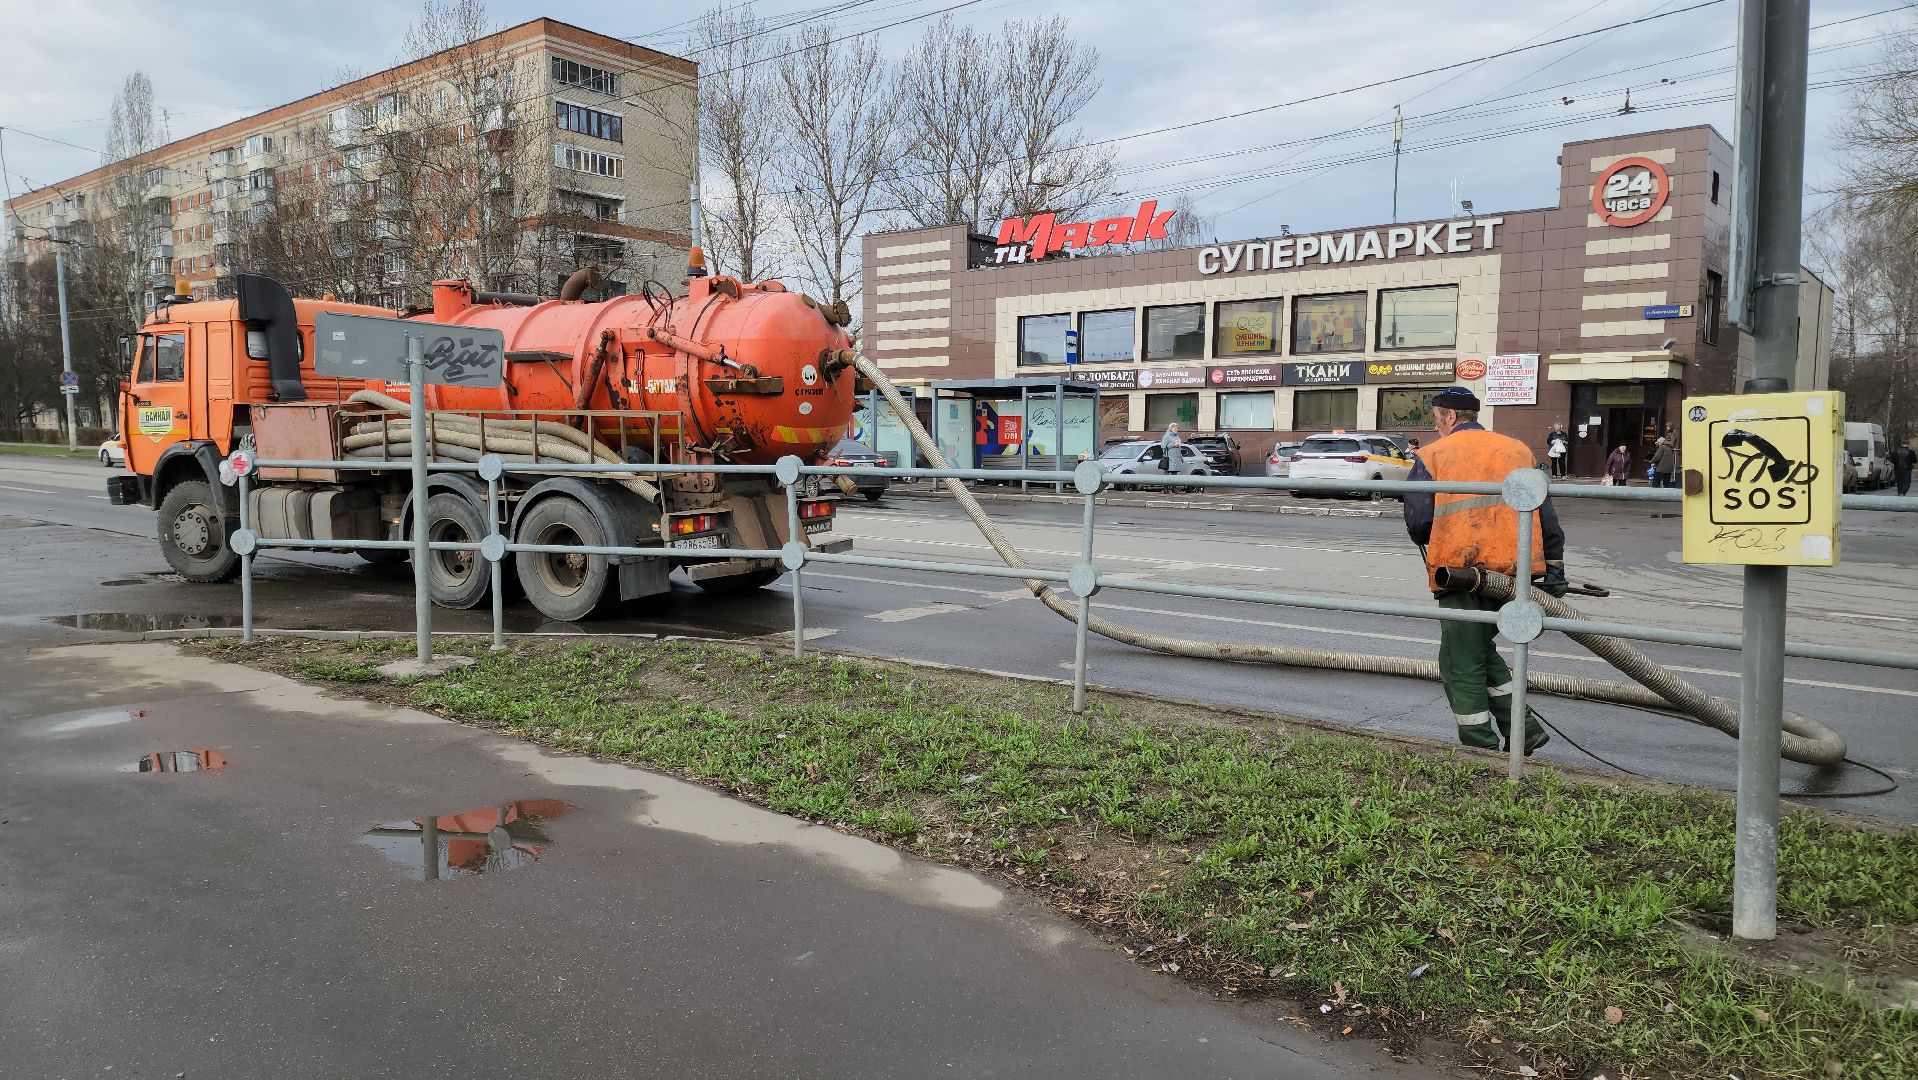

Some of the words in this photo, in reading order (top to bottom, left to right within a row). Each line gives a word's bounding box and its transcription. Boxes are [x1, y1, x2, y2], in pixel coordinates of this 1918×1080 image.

[1607, 171, 1651, 198] 24
[1605, 197, 1652, 211] часа
[1198, 217, 1504, 275] СУПЕРМАРКЕТ
[1237, 340, 1255, 348] ЦЕНЫ
[1089, 371, 1134, 382] ЛОМБАРД
[1295, 363, 1351, 378] ТКАНИ
[1723, 486, 1797, 510] SOS
[804, 522, 831, 533] AMAZ
